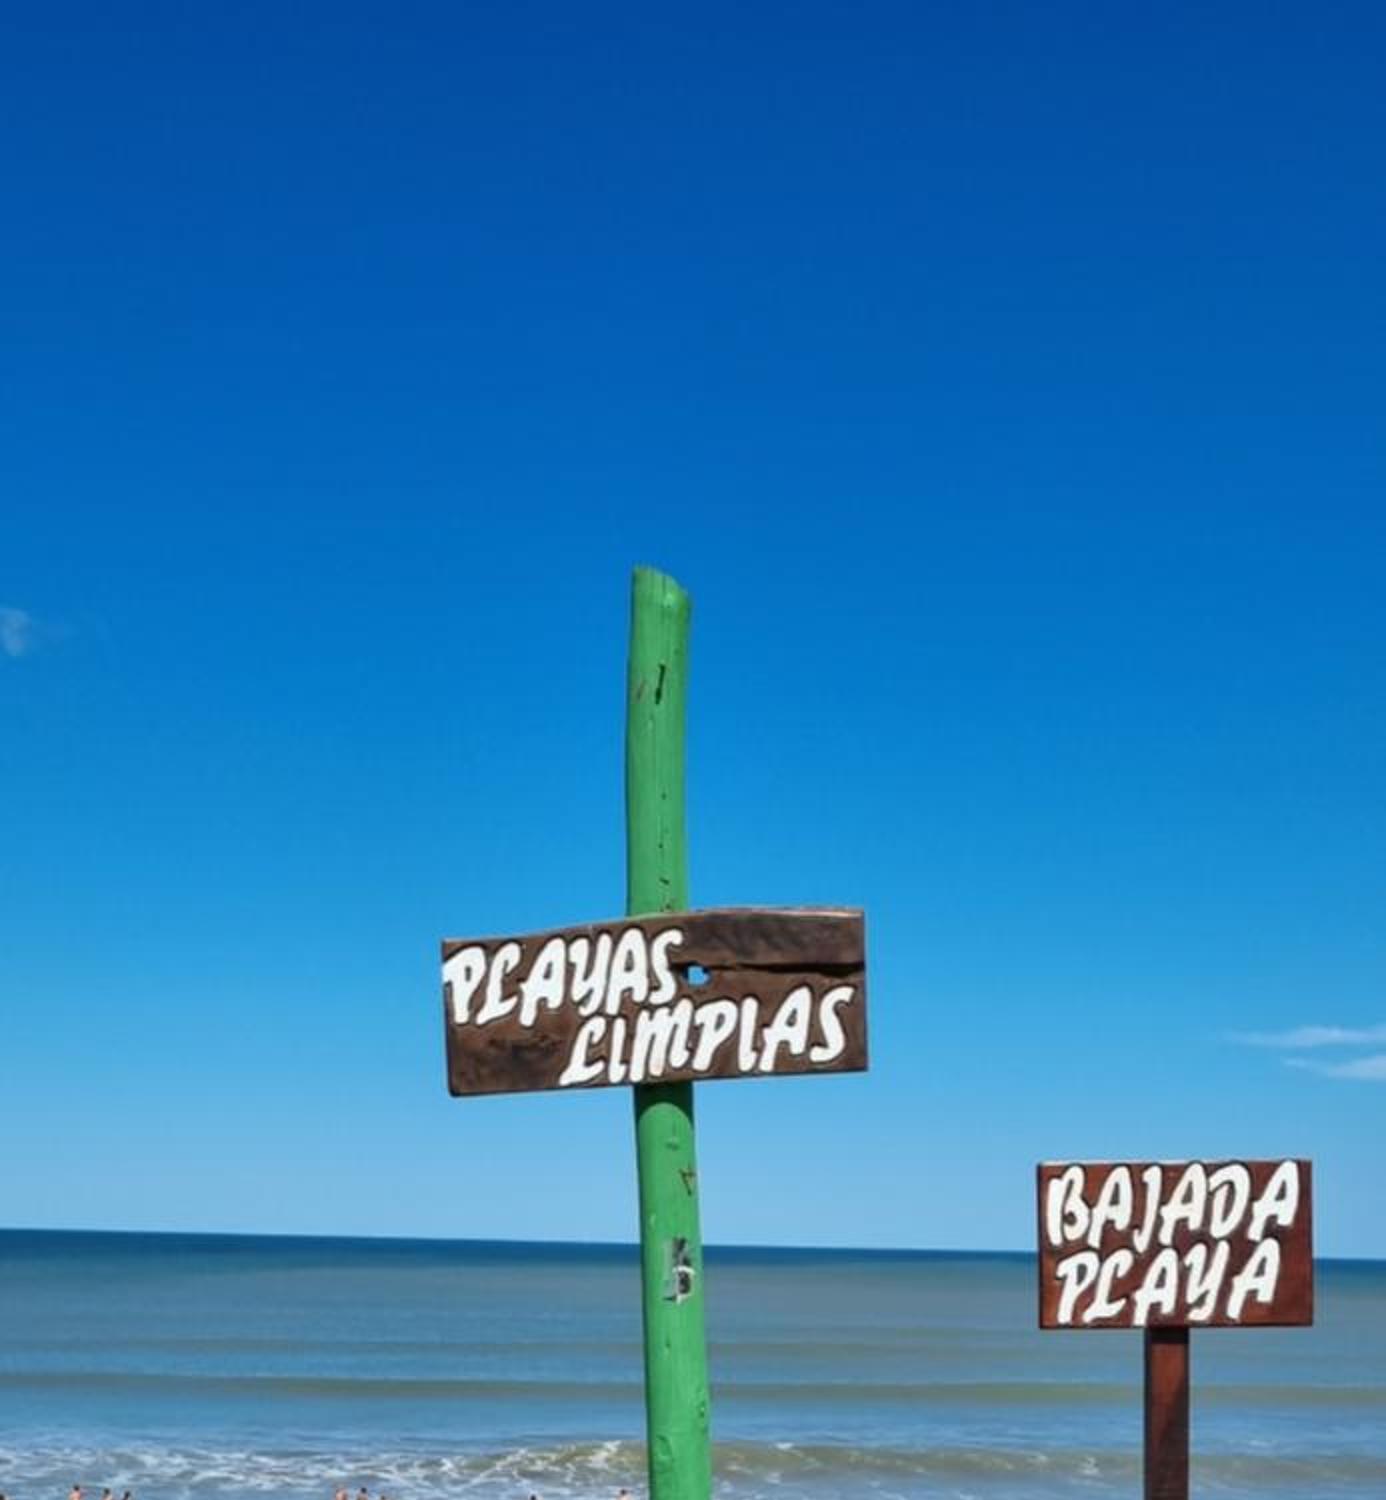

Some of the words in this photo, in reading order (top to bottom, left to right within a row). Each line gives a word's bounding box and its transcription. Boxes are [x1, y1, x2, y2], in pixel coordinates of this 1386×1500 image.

[442, 928, 684, 1027] PLAYAS
[559, 986, 855, 1086] LIMPIAS
[1046, 1160, 1299, 1254] BAJADA
[1055, 1237, 1281, 1327] PLAYA
